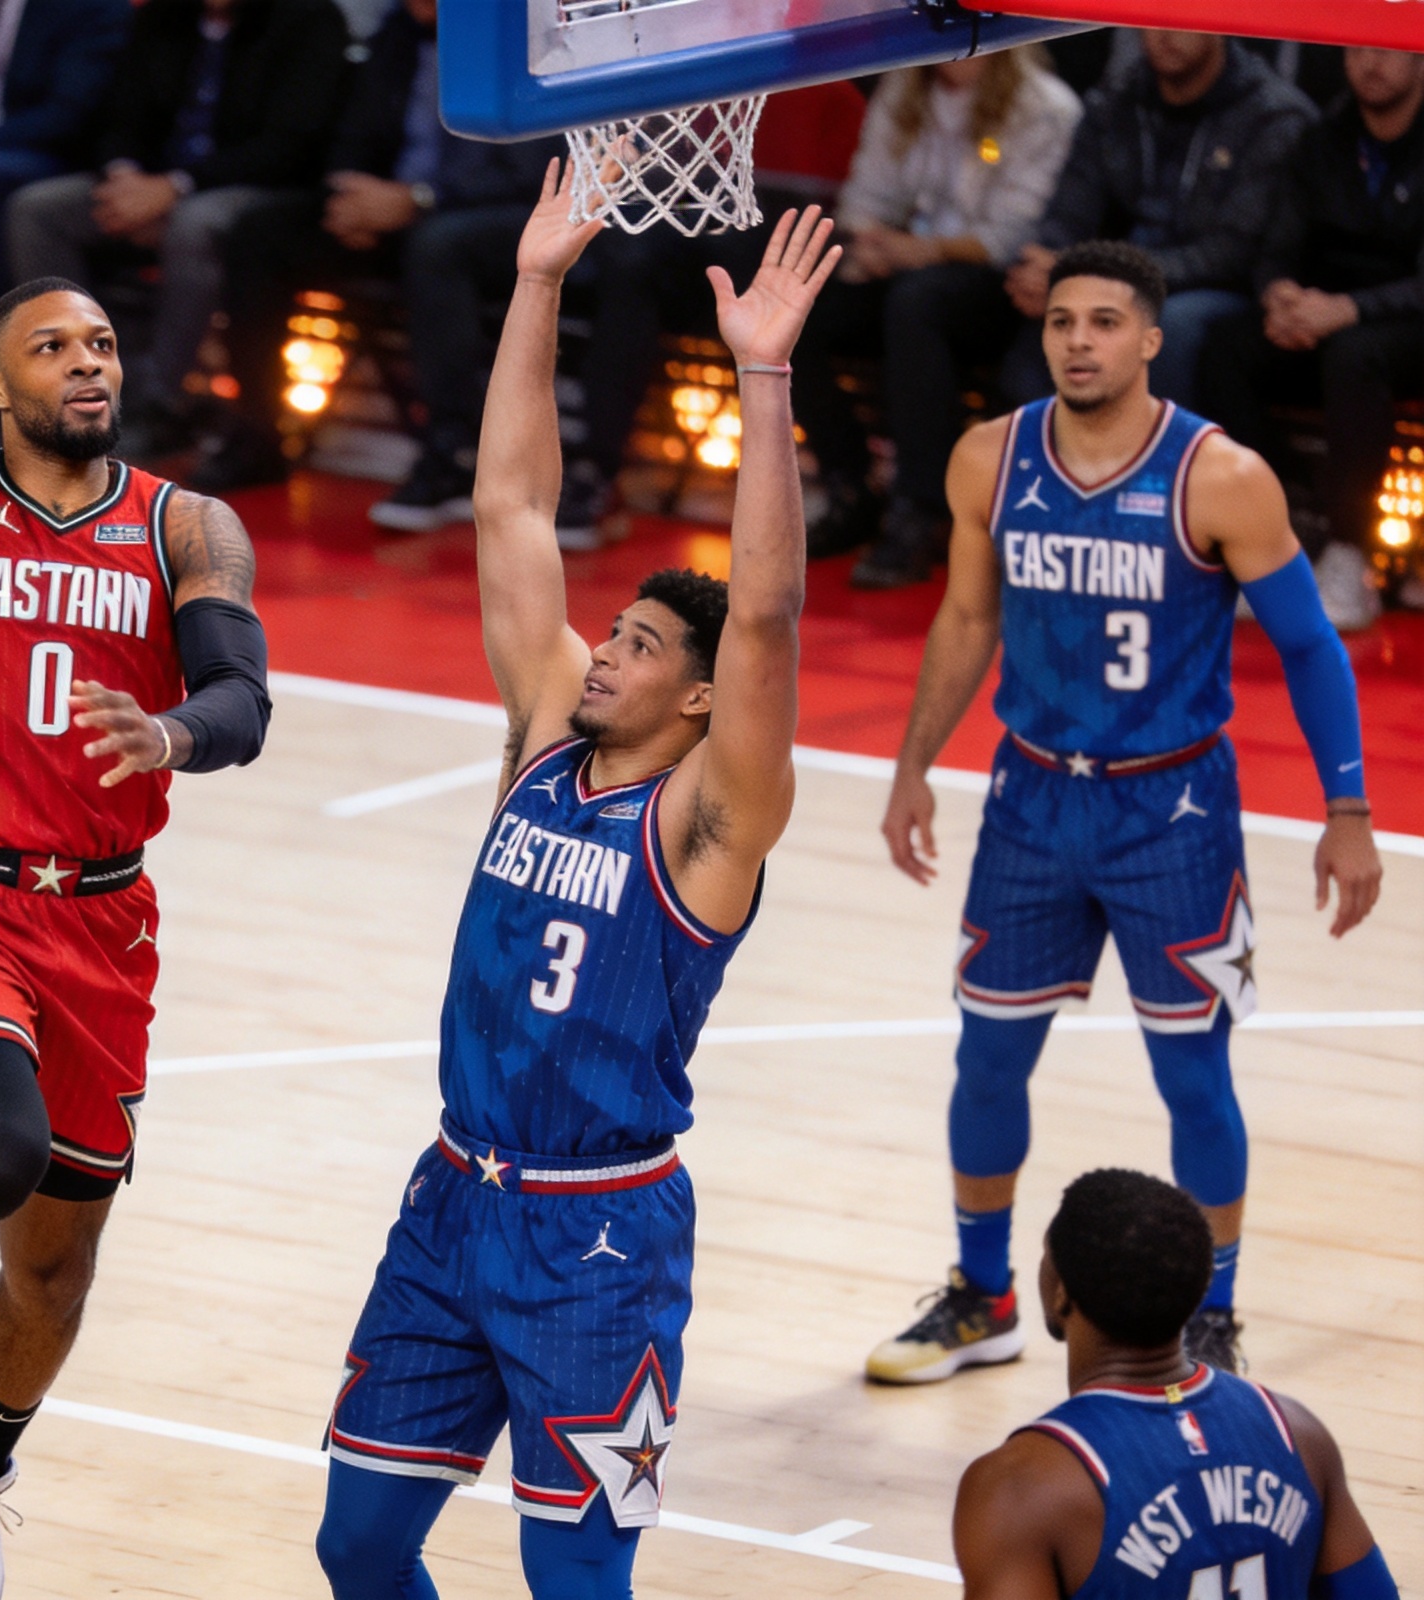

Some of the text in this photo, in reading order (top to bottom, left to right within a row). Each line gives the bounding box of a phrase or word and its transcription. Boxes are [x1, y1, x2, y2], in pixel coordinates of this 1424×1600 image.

[1003, 530, 1165, 601] EASTARN
[28, 641, 74, 736] 0
[1105, 610, 1150, 691] 3
[481, 811, 632, 917] EASTARN
[530, 919, 588, 1015] 3
[1115, 1483, 1193, 1580] WST
